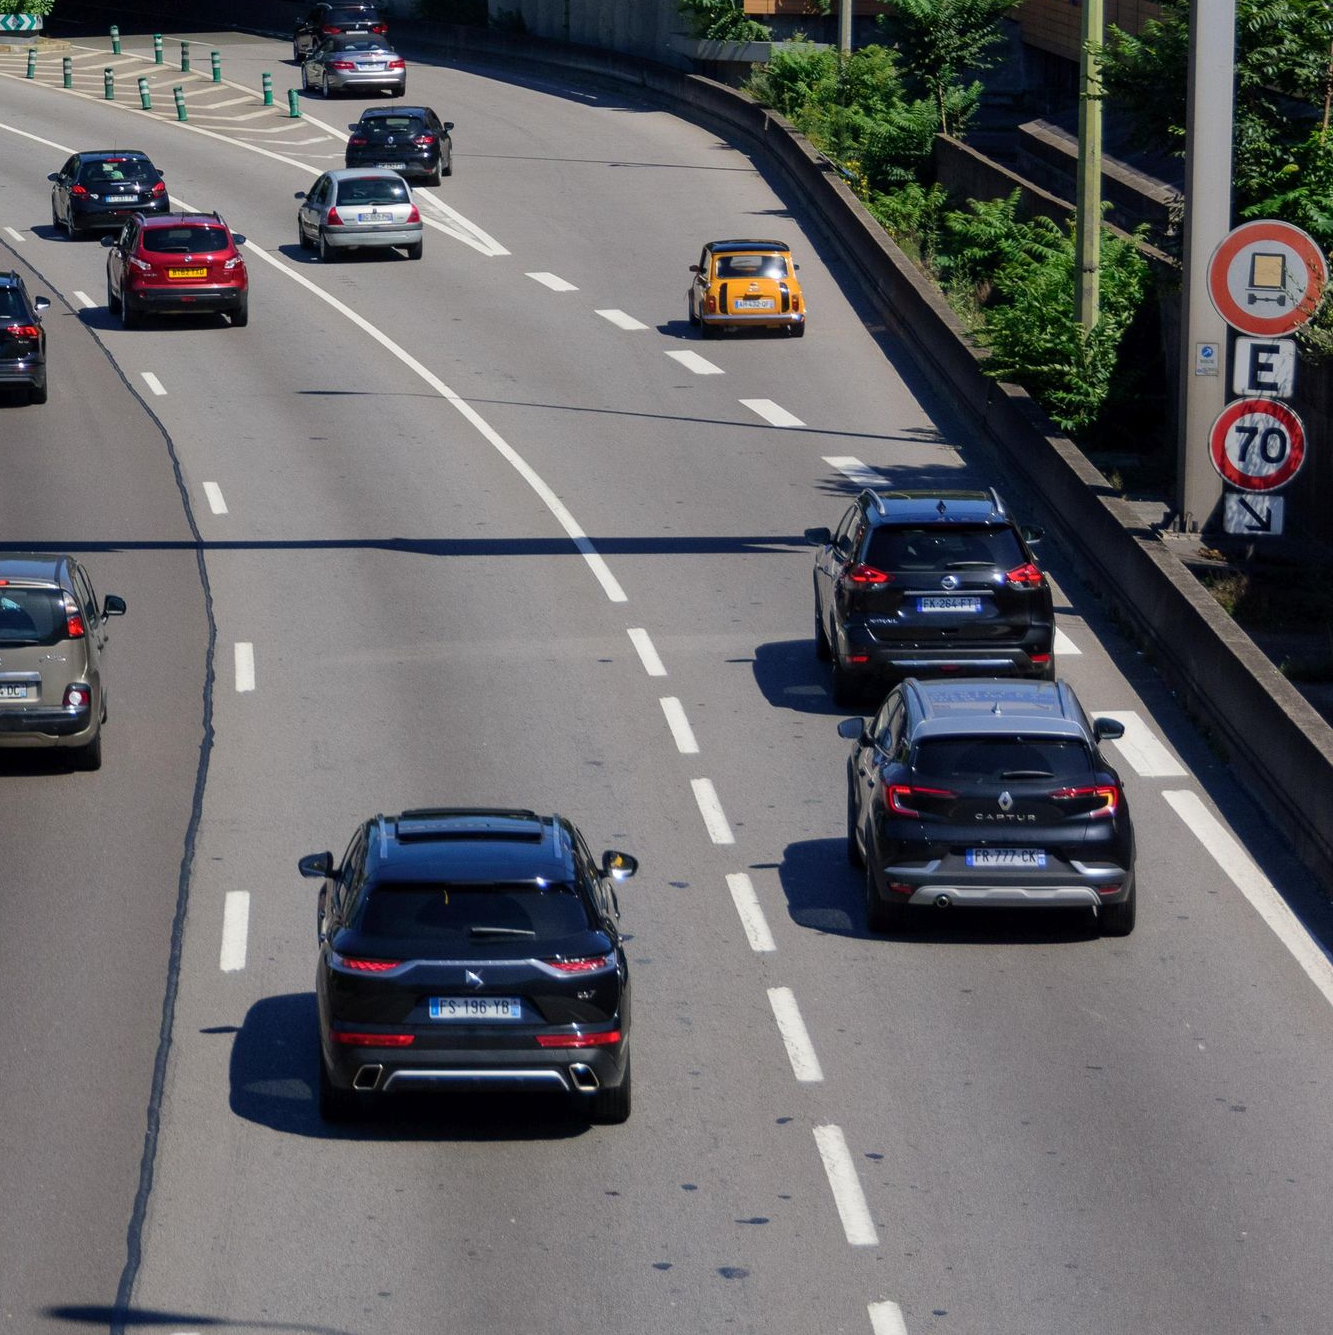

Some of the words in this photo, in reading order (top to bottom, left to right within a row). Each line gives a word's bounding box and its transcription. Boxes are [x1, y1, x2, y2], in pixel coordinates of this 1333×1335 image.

[1247, 343, 1280, 392] E
[1234, 425, 1288, 465] 70
[974, 813, 1036, 821] CAPTUR
